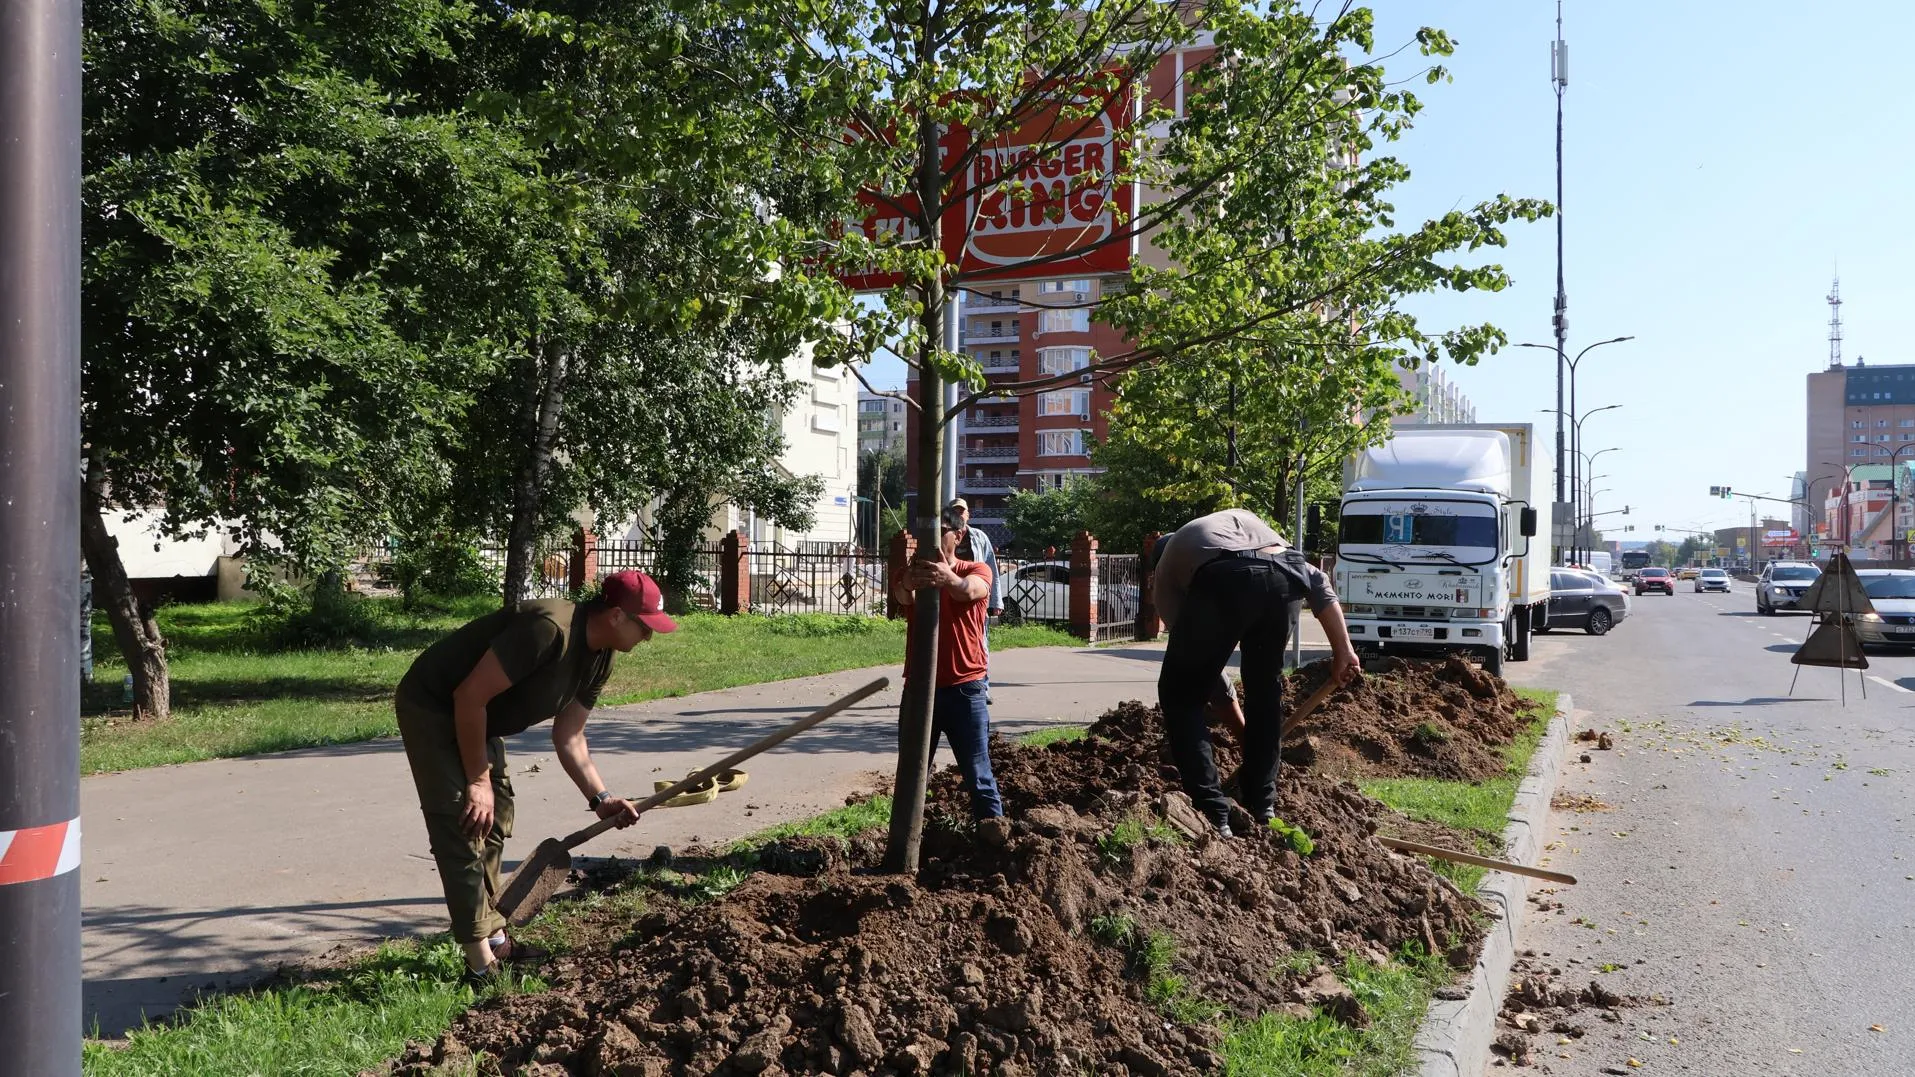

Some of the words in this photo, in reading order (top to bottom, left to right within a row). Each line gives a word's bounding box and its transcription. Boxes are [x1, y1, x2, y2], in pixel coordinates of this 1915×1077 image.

[974, 143, 1105, 185] BURGER
[974, 176, 1105, 231] KING
[1427, 592, 1453, 601] MORI
